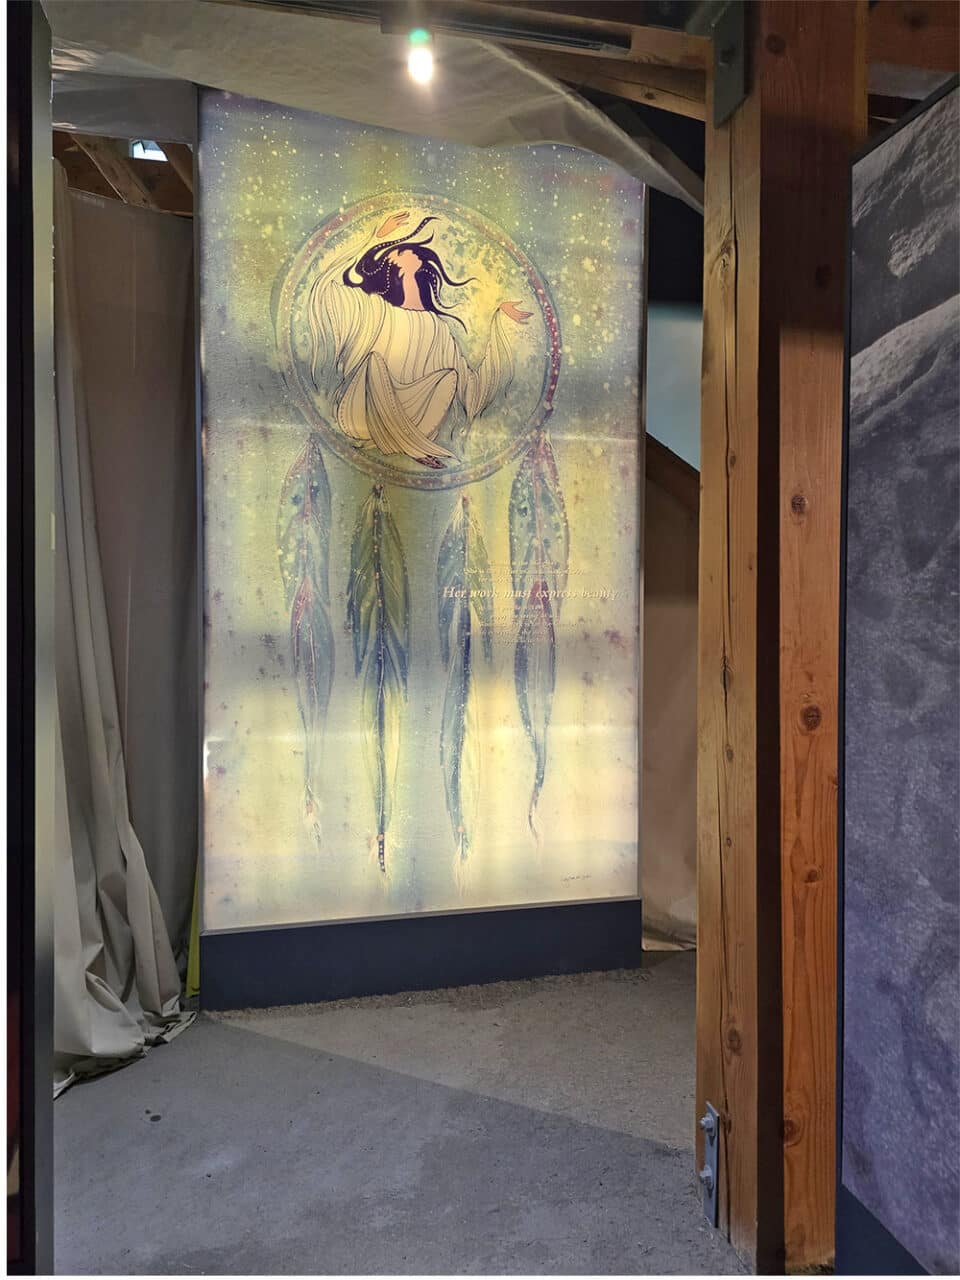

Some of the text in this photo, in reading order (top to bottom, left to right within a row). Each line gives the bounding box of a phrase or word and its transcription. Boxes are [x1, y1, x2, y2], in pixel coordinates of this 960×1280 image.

[442, 586, 466, 598] Her
[470, 586, 498, 598] work
[504, 588, 531, 598] must
[536, 590, 578, 600] express
